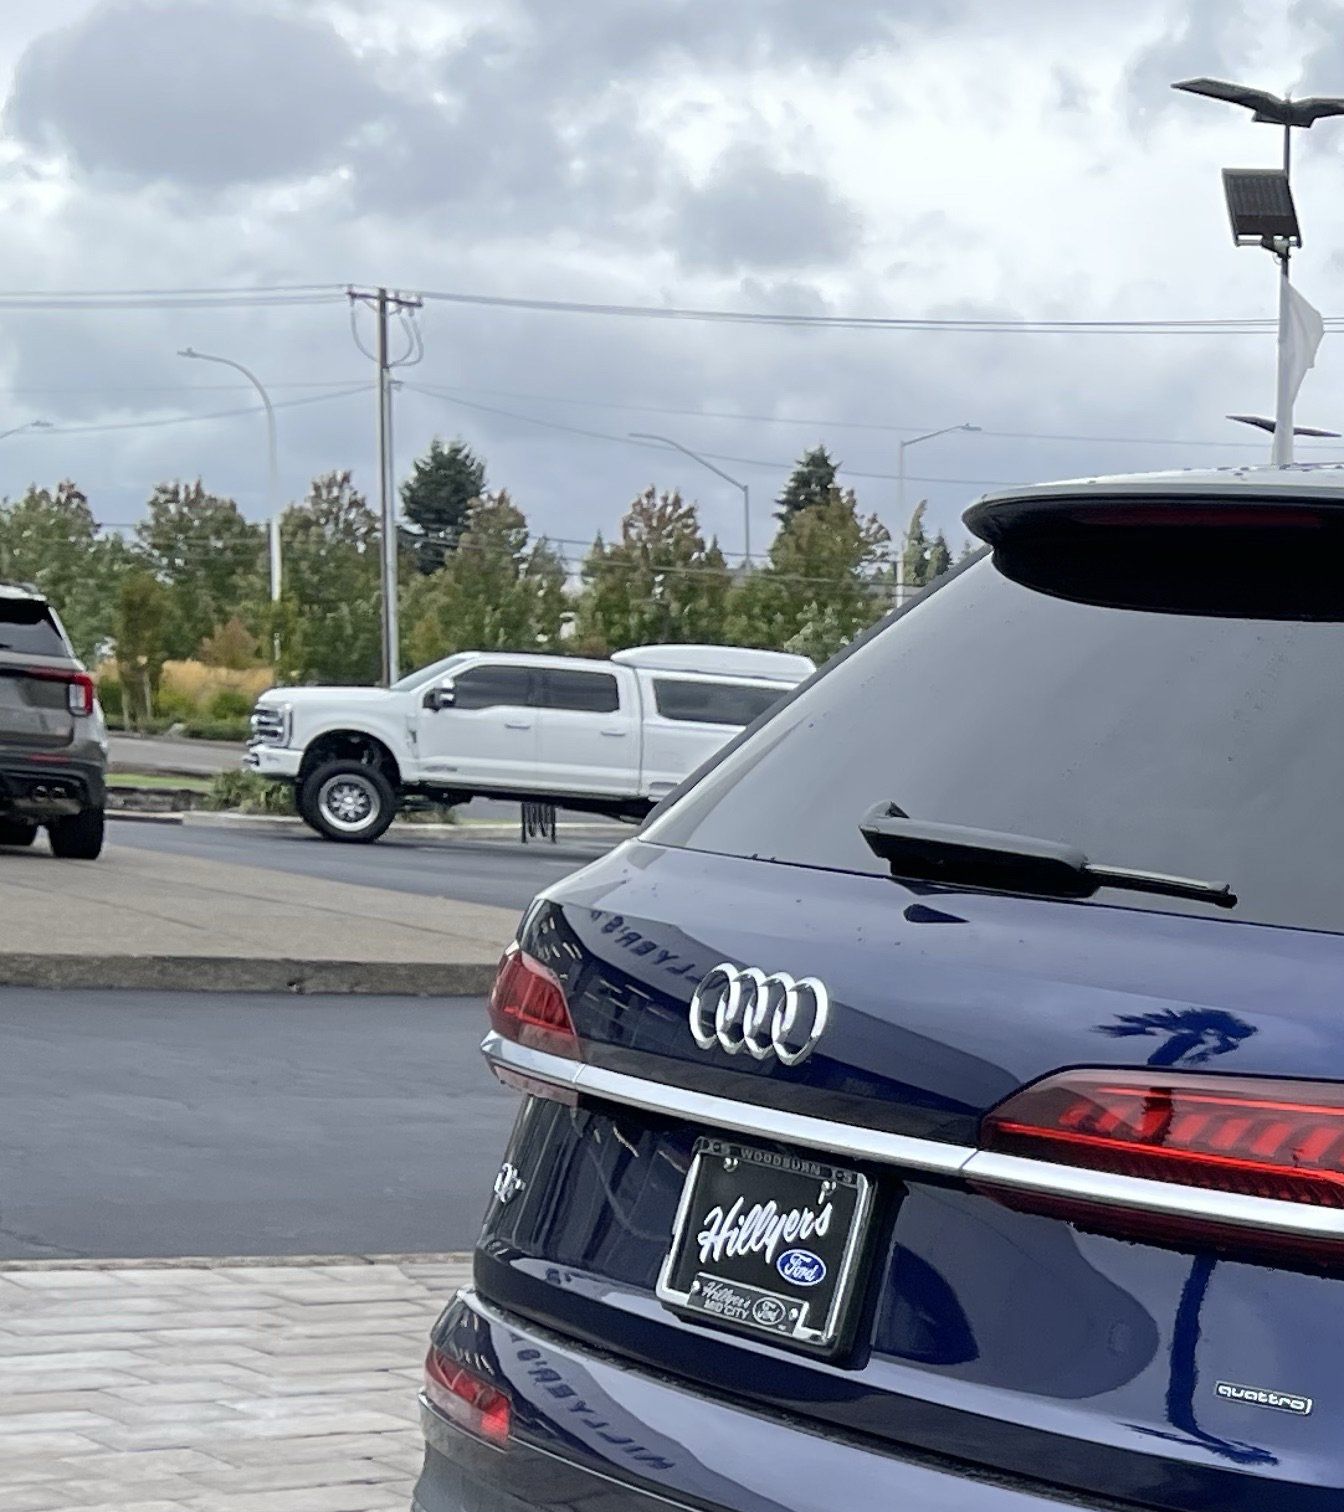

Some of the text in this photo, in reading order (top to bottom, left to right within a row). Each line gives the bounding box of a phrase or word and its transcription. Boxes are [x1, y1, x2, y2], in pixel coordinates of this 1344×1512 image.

[741, 1149, 822, 1176] WOODBURN
[782, 1253, 823, 1283] Ford
[724, 1305, 749, 1320] CITY
[1217, 1384, 1305, 1410] quattro
